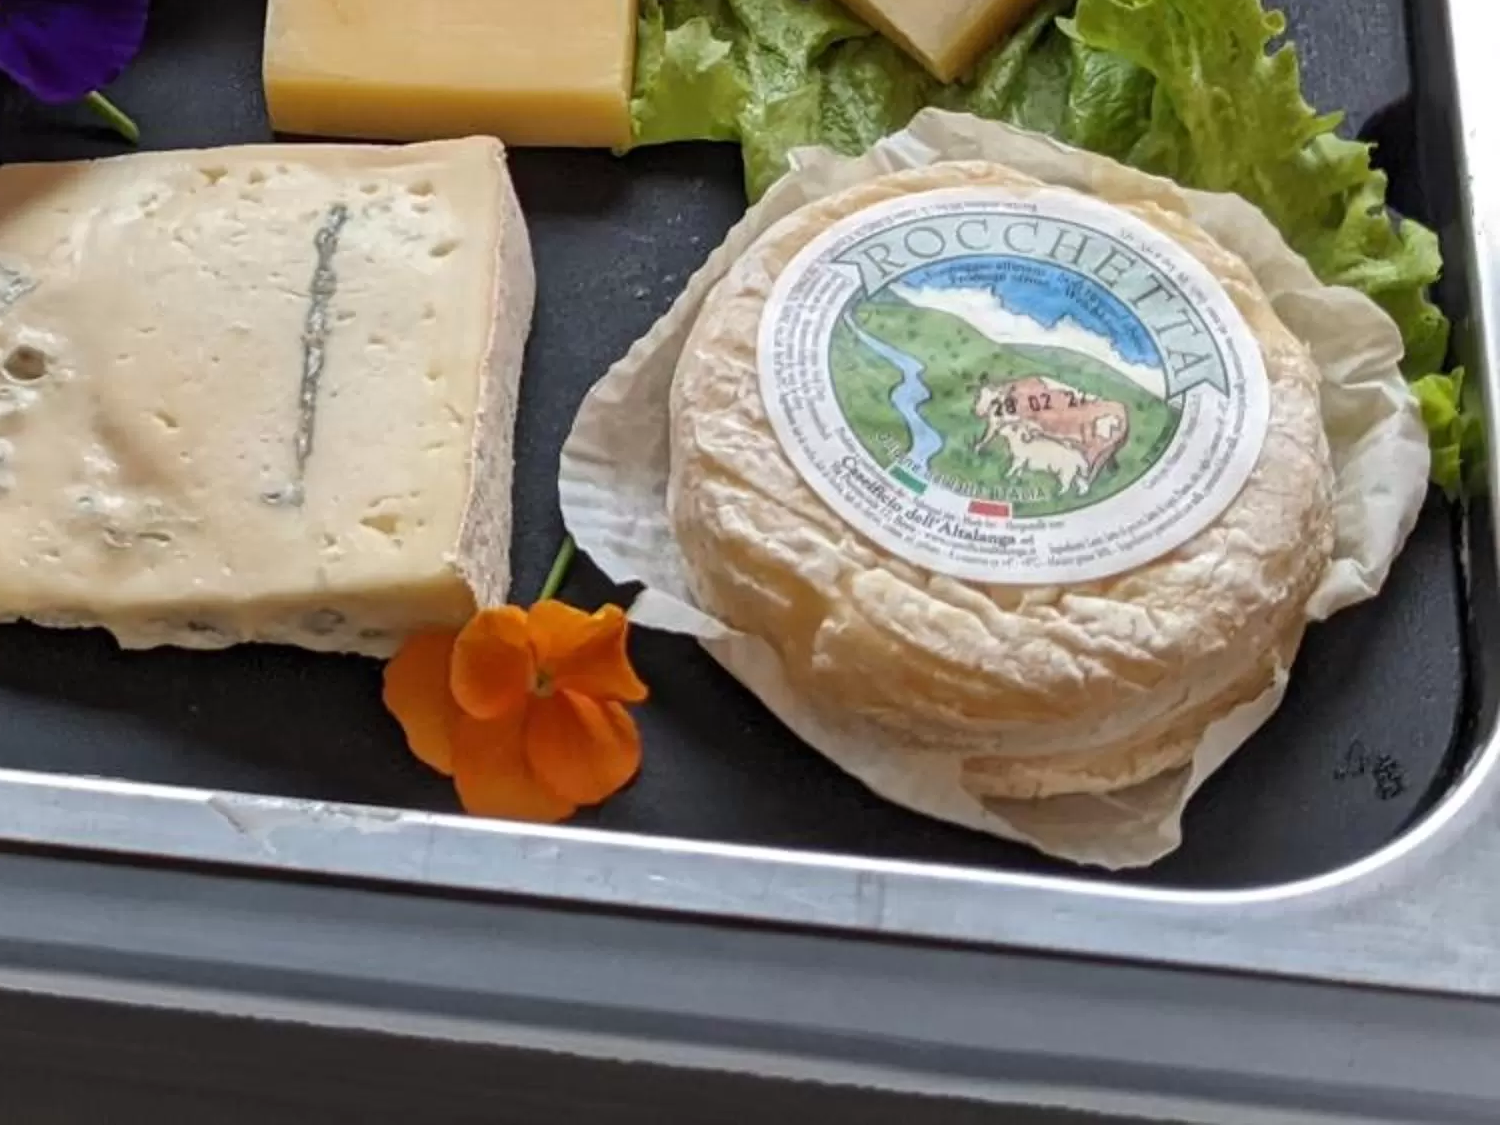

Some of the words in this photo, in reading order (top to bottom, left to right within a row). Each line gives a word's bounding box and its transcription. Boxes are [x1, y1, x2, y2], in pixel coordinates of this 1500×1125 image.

[862, 217, 1214, 379] ROCCHETTA
[991, 396, 1018, 417] 28
[1028, 392, 1052, 412] 02
